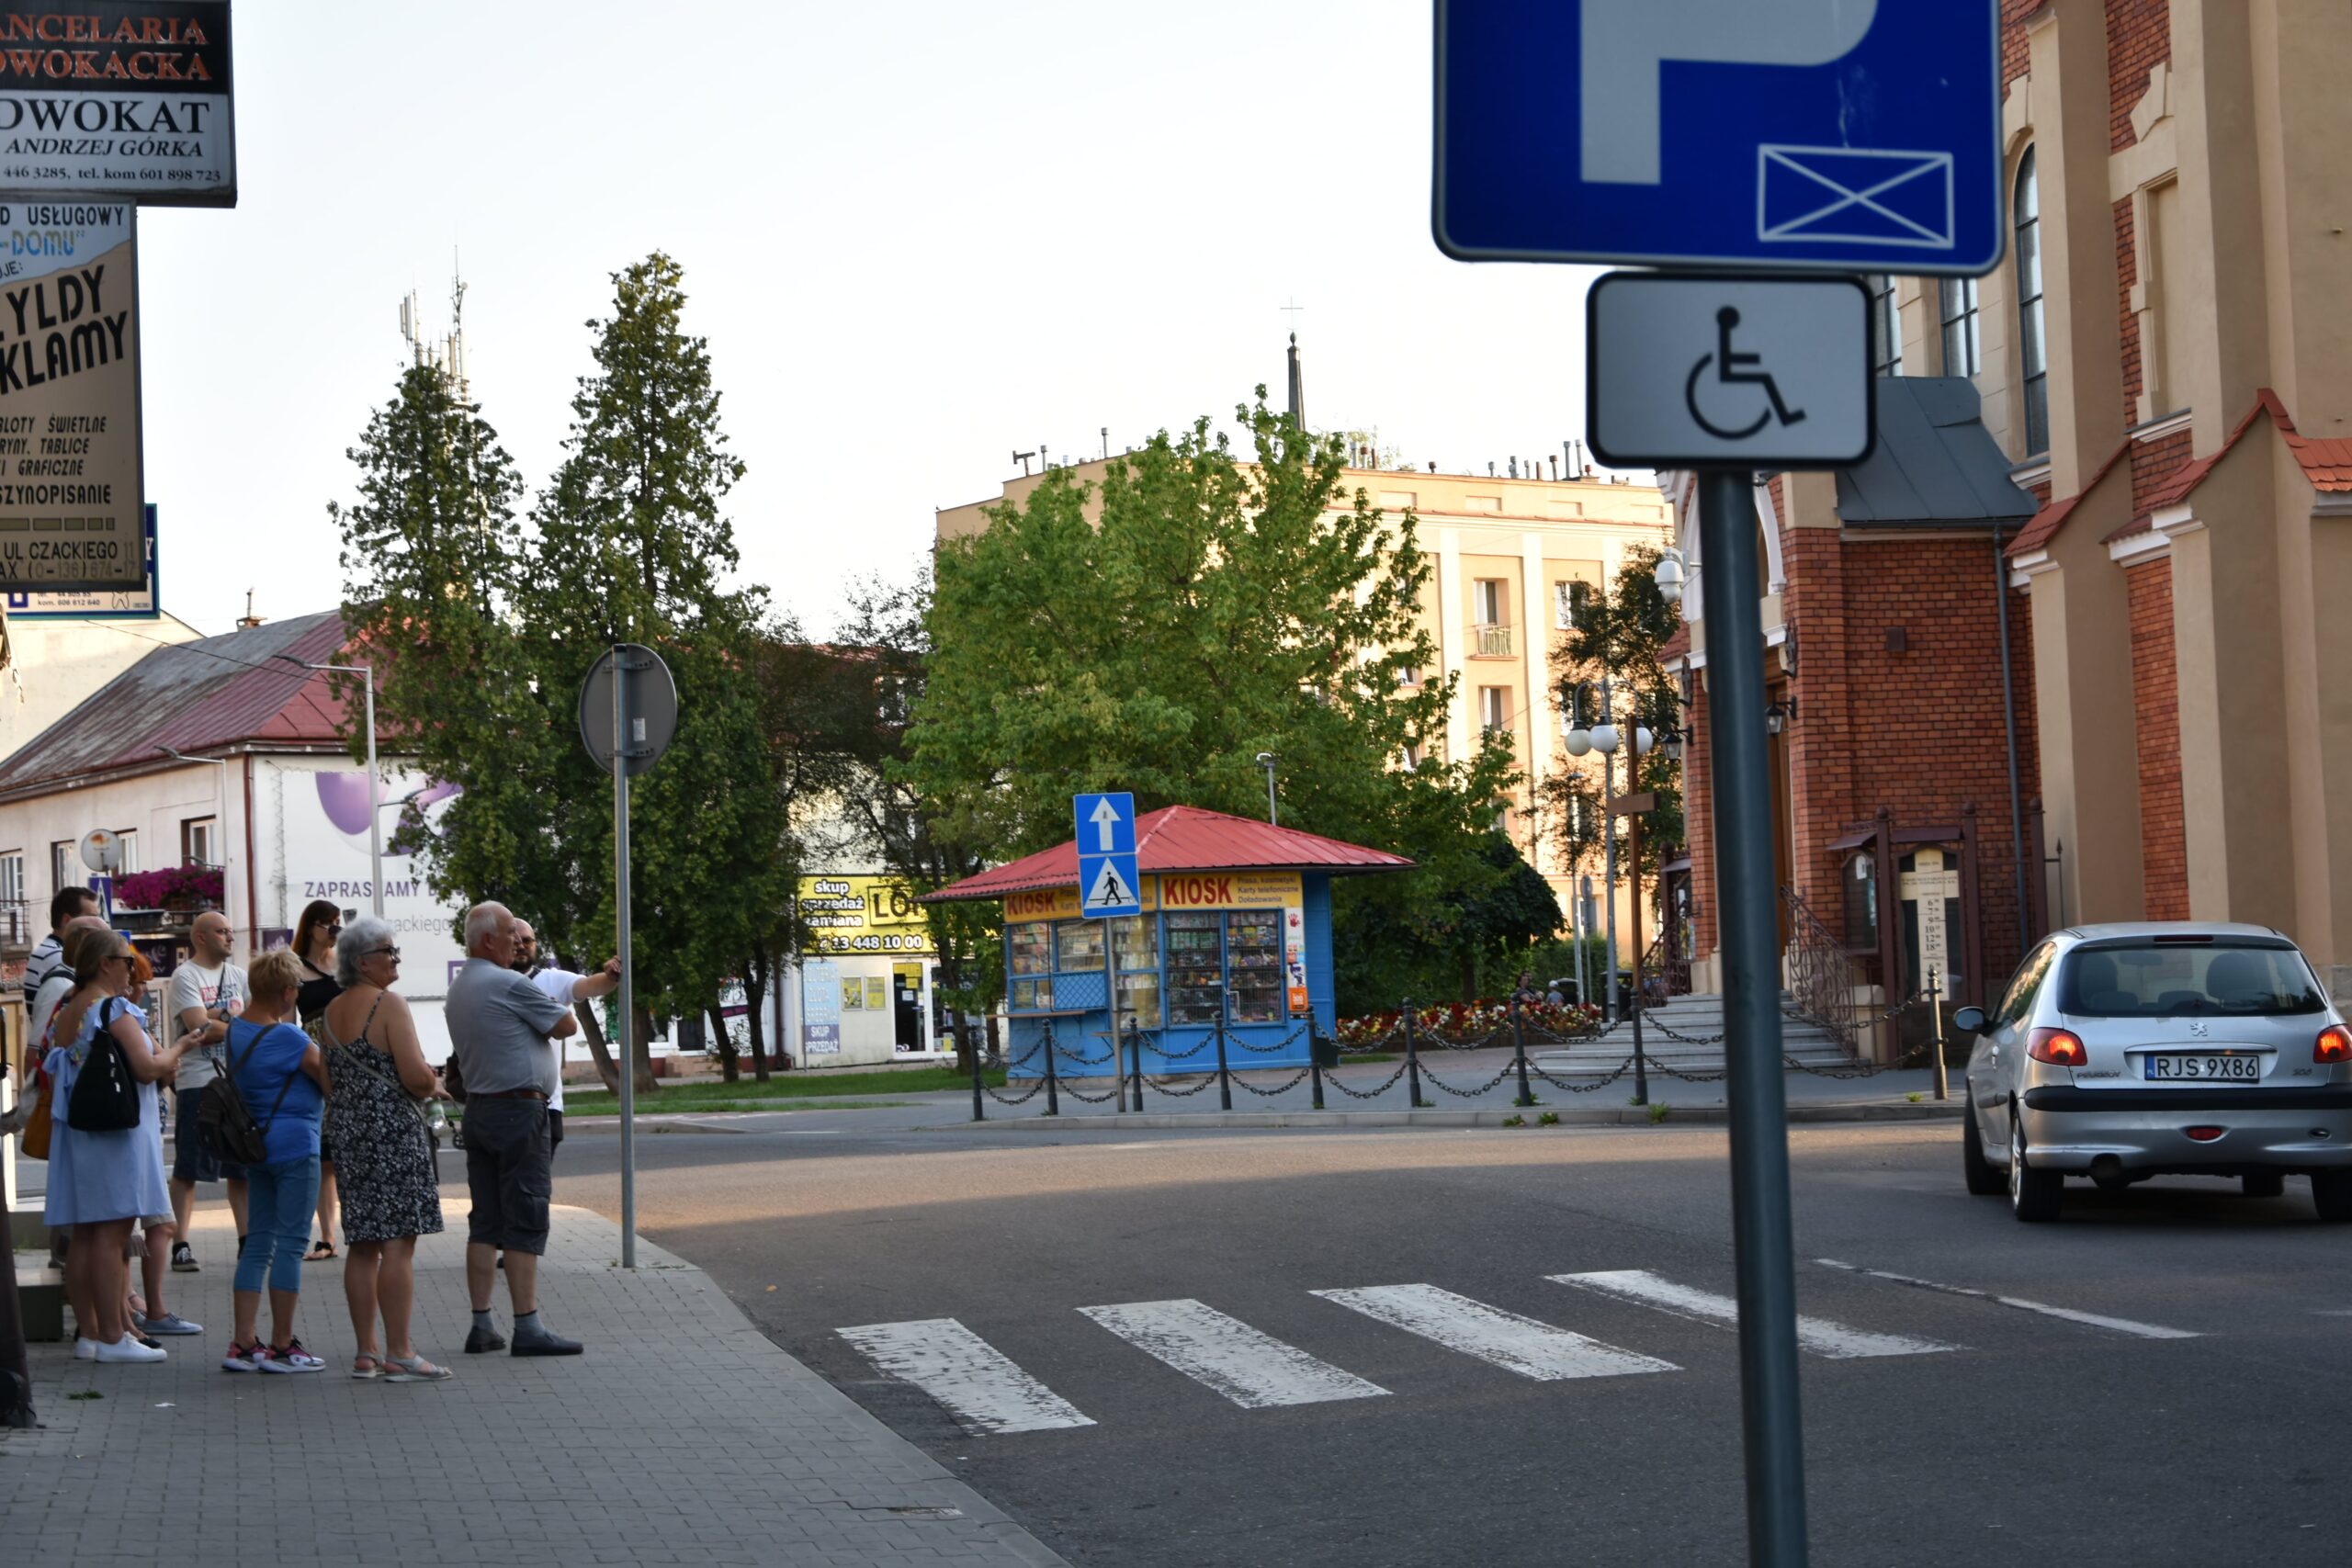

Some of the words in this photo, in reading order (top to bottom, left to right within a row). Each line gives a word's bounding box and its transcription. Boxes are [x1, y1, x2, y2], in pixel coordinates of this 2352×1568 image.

[0, 50, 212, 80] WOKACKA
[5, 137, 116, 156] ANDRZEJ
[119, 136, 203, 157] GÓRKA
[33, 167, 71, 180] 3285,
[78, 167, 100, 180] tel.
[104, 167, 136, 180] kom
[140, 168, 163, 181] 601
[167, 169, 193, 182] 898
[196, 169, 221, 182] 723
[28, 206, 123, 227] USŁUGOWY
[0, 265, 105, 342] YLDY
[40, 437, 90, 455] TABLICE
[18, 459, 84, 477] GRAFICZNE
[28, 541, 118, 559] CZACKIEGO
[814, 879, 849, 896] skup
[1164, 877, 1232, 905] KIOSK
[1007, 892, 1057, 915] KIOSK
[392, 914, 451, 935] ackiego
[853, 936, 881, 950] 448
[883, 936, 901, 949] 10
[904, 935, 923, 948] 00
[2156, 1058, 2199, 1077] RJS
[2207, 1058, 2256, 1077] 9X86
